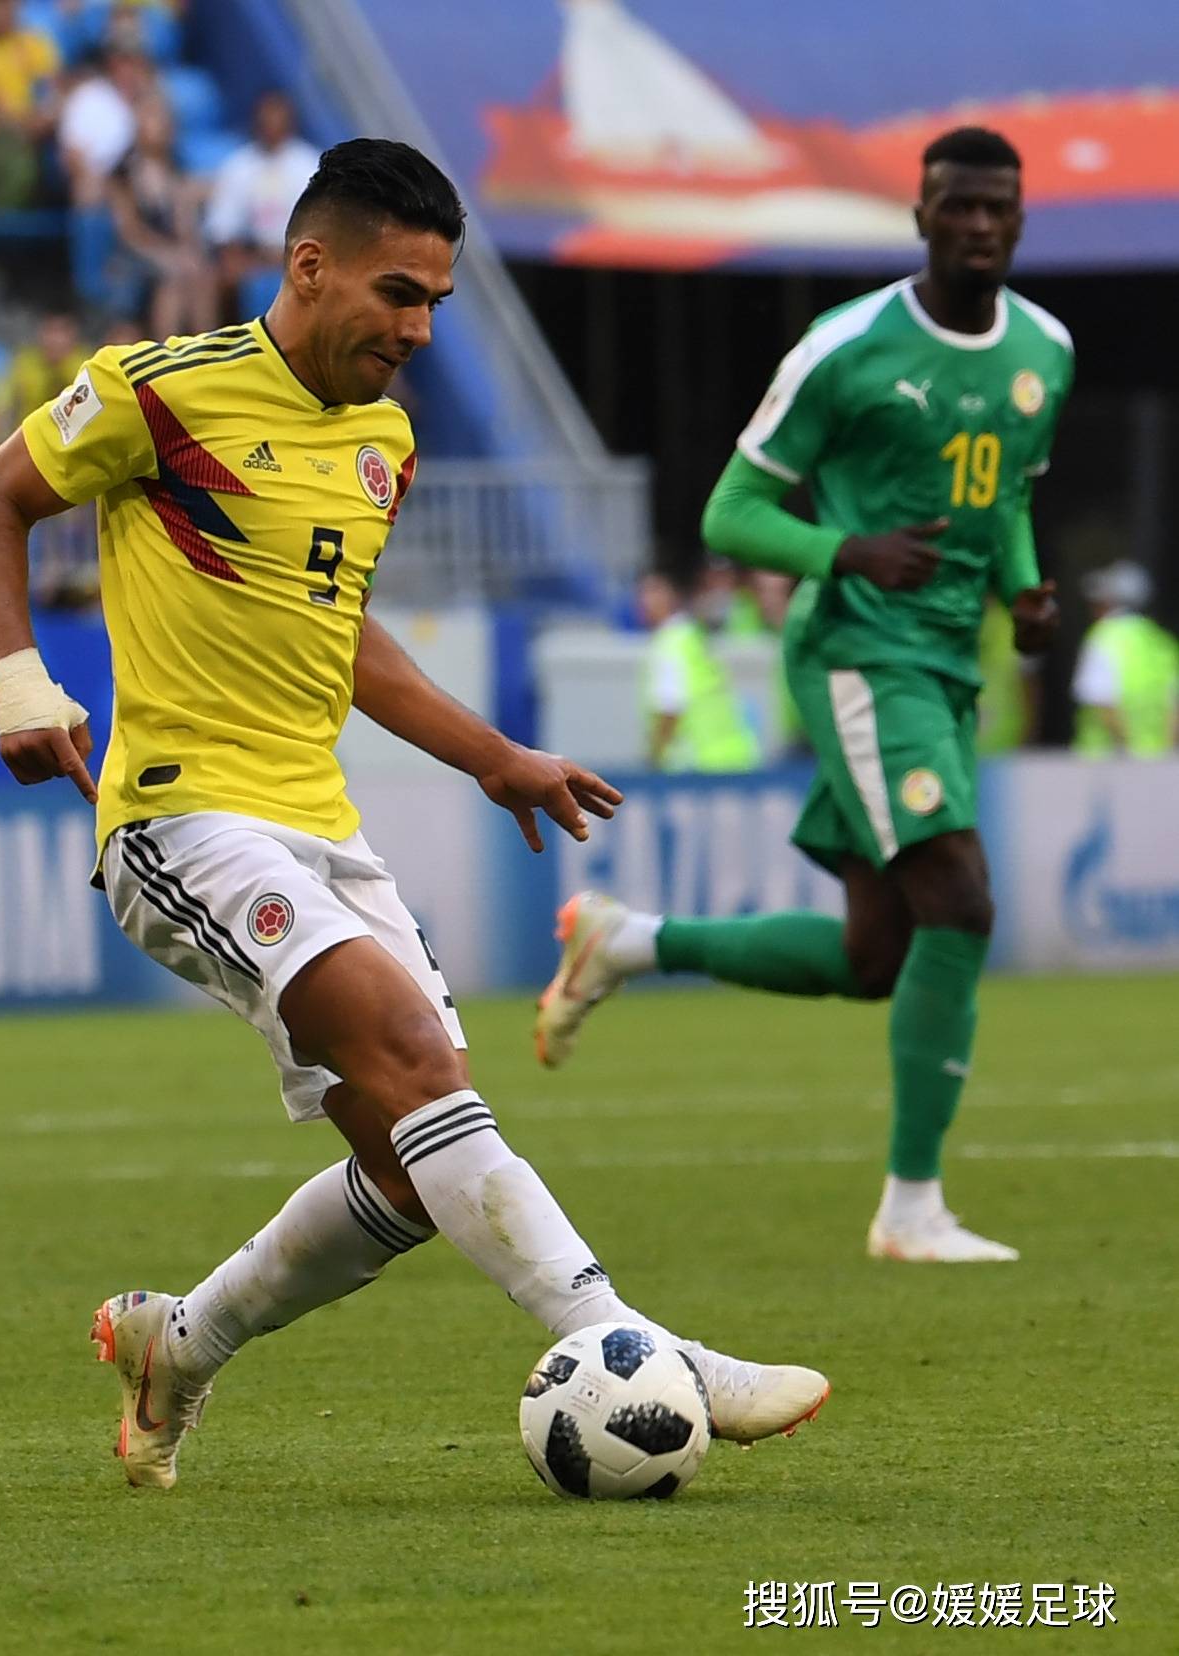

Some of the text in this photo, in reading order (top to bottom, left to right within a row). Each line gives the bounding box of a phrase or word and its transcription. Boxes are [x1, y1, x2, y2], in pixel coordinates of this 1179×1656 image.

[242, 459, 283, 473] adidas
[940, 432, 1001, 508] 19
[305, 525, 344, 607] 9
